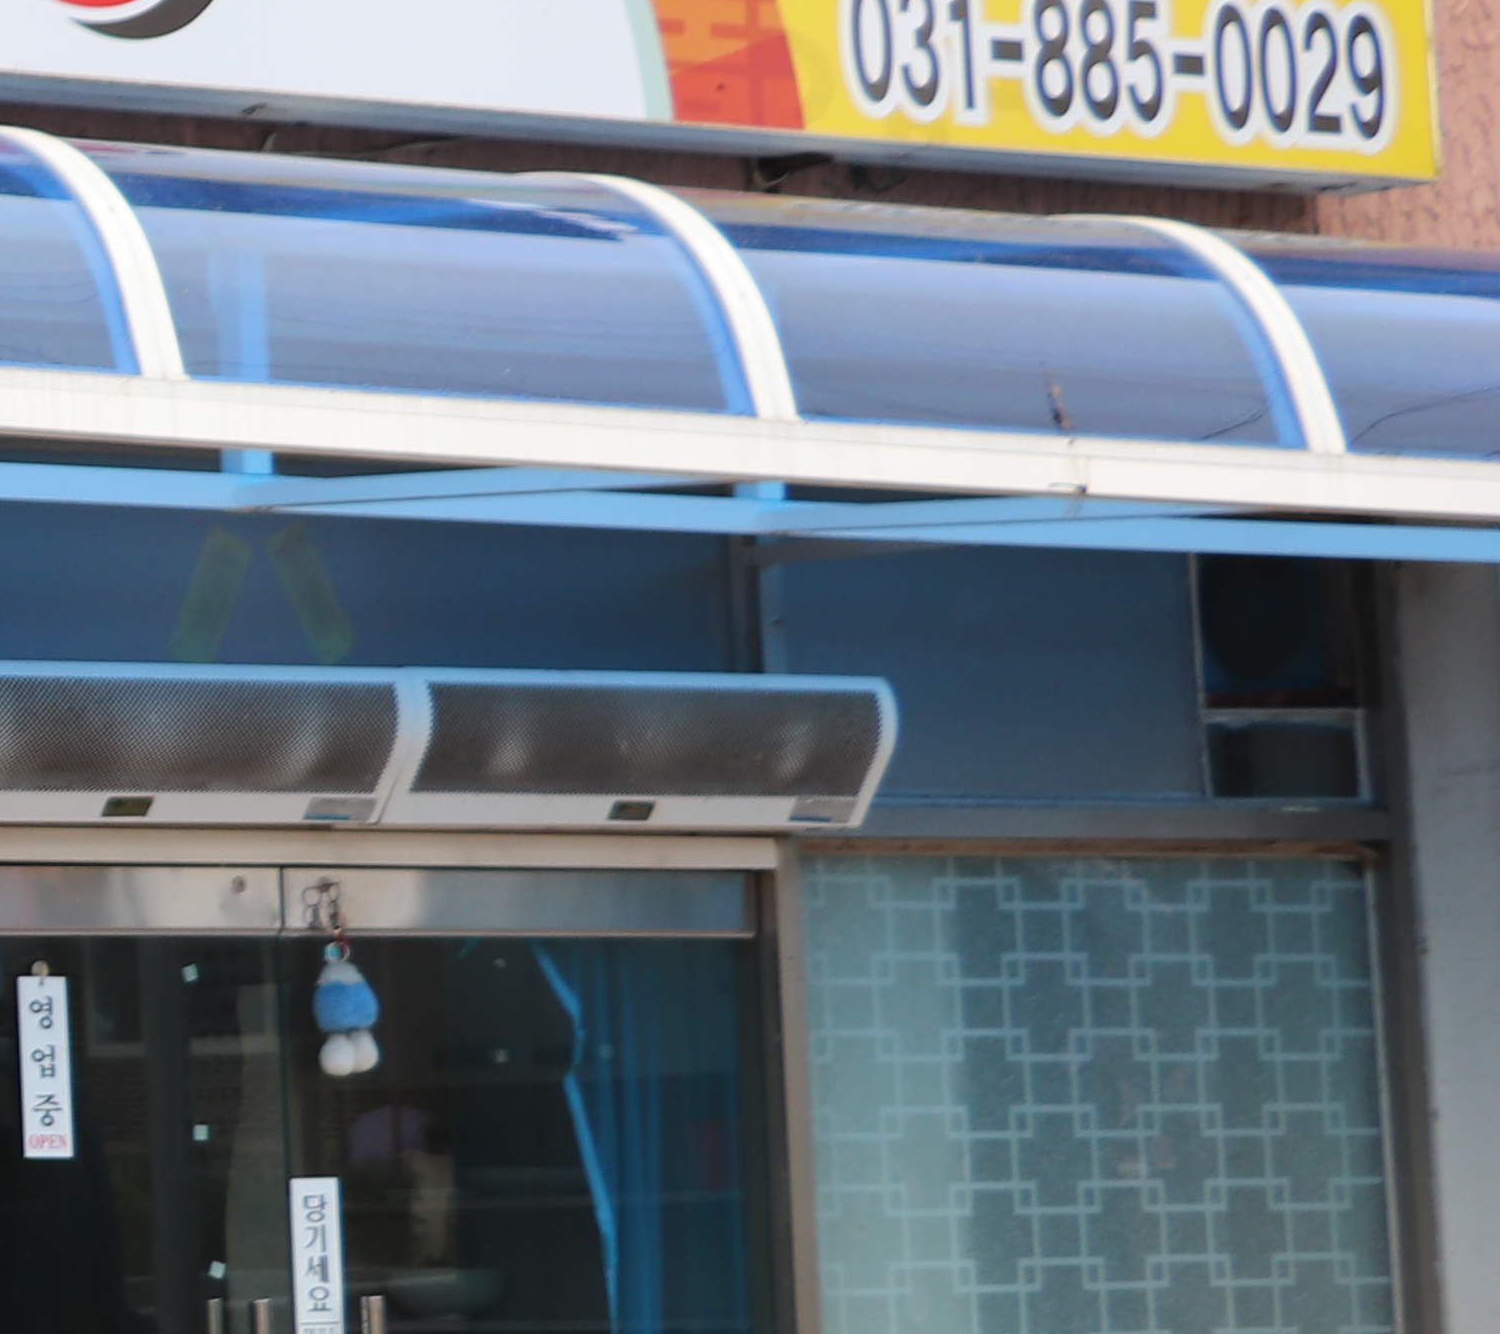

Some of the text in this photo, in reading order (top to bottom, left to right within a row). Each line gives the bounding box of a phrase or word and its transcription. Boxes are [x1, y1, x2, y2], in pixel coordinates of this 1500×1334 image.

[28, 995, 63, 1127] 영업중
[28, 1133, 68, 1150] OPEN
[302, 1193, 332, 1312] 당기세요
